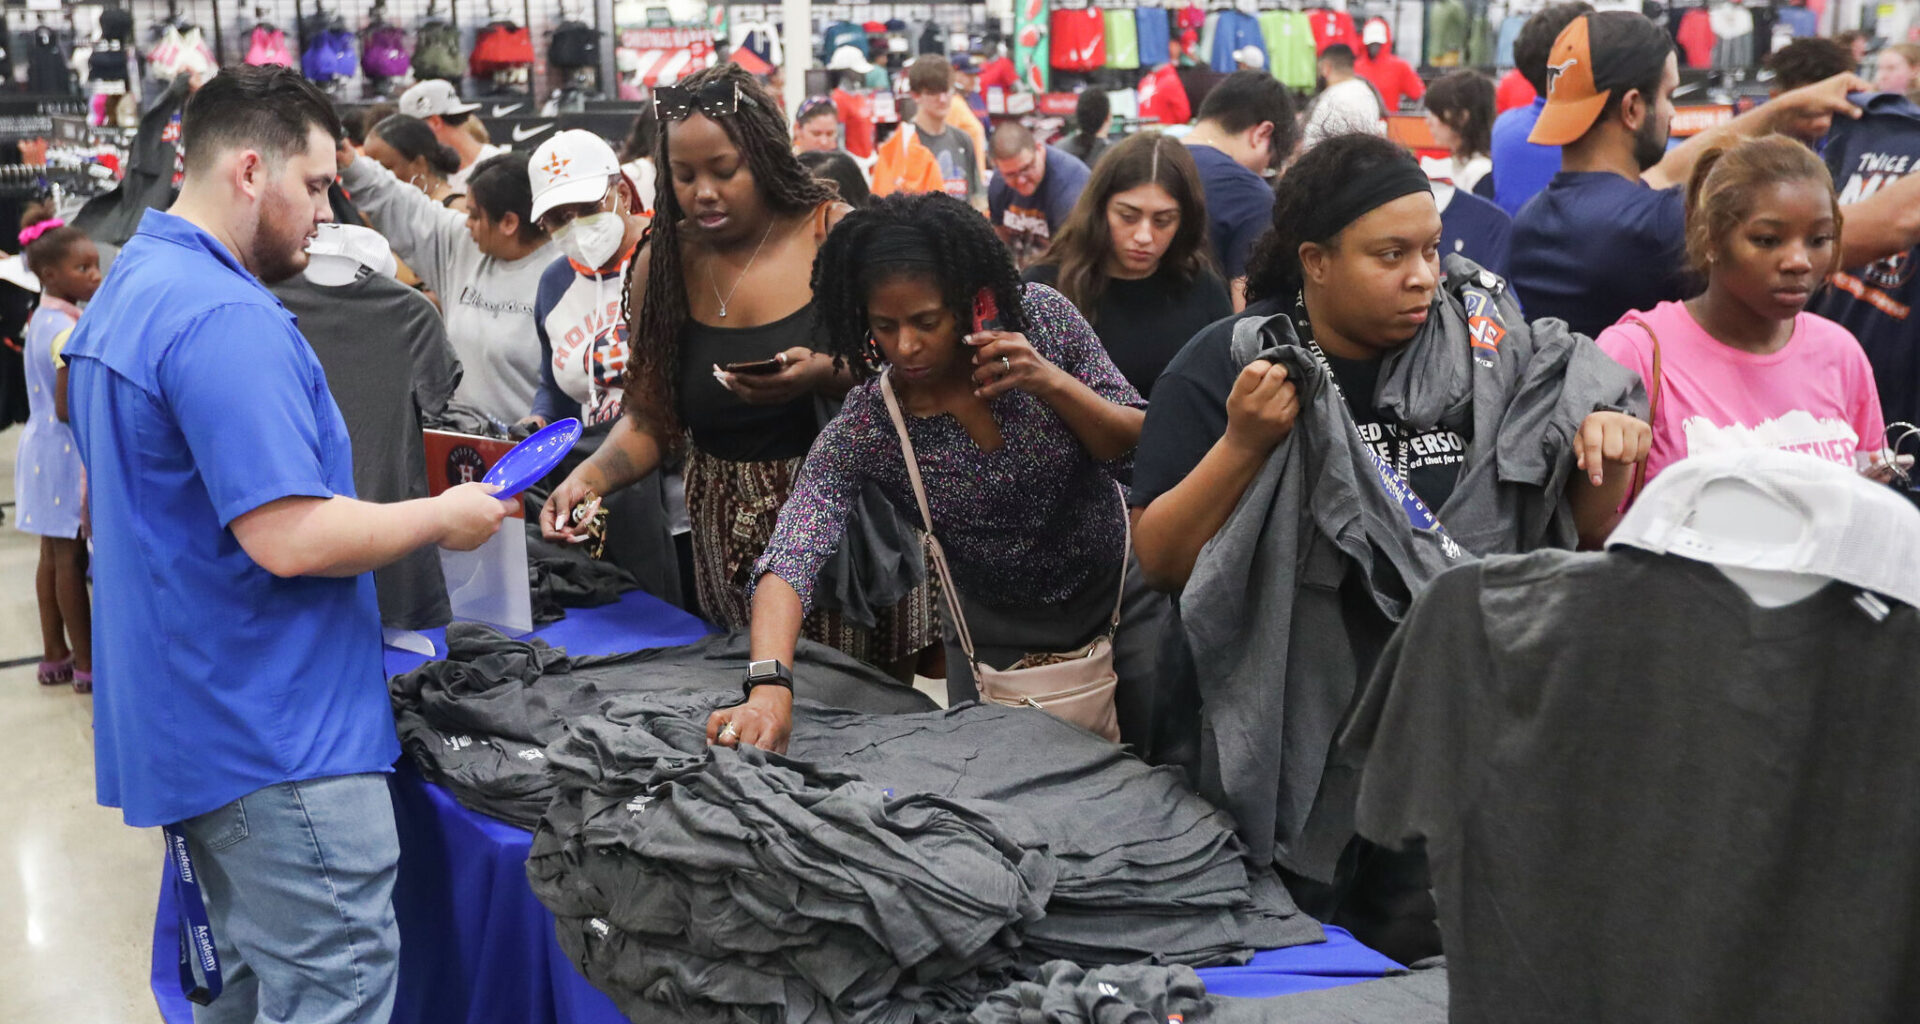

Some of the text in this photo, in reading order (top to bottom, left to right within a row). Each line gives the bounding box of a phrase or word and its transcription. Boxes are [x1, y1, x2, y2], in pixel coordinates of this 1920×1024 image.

[1857, 152, 1910, 173] TWICE
[1410, 431, 1463, 456] ERSO
[1424, 455, 1443, 466] that
[1443, 455, 1455, 465] for
[1392, 474, 1434, 523] WORLD
[175, 835, 194, 884] Academy
[197, 924, 218, 972] Academy
